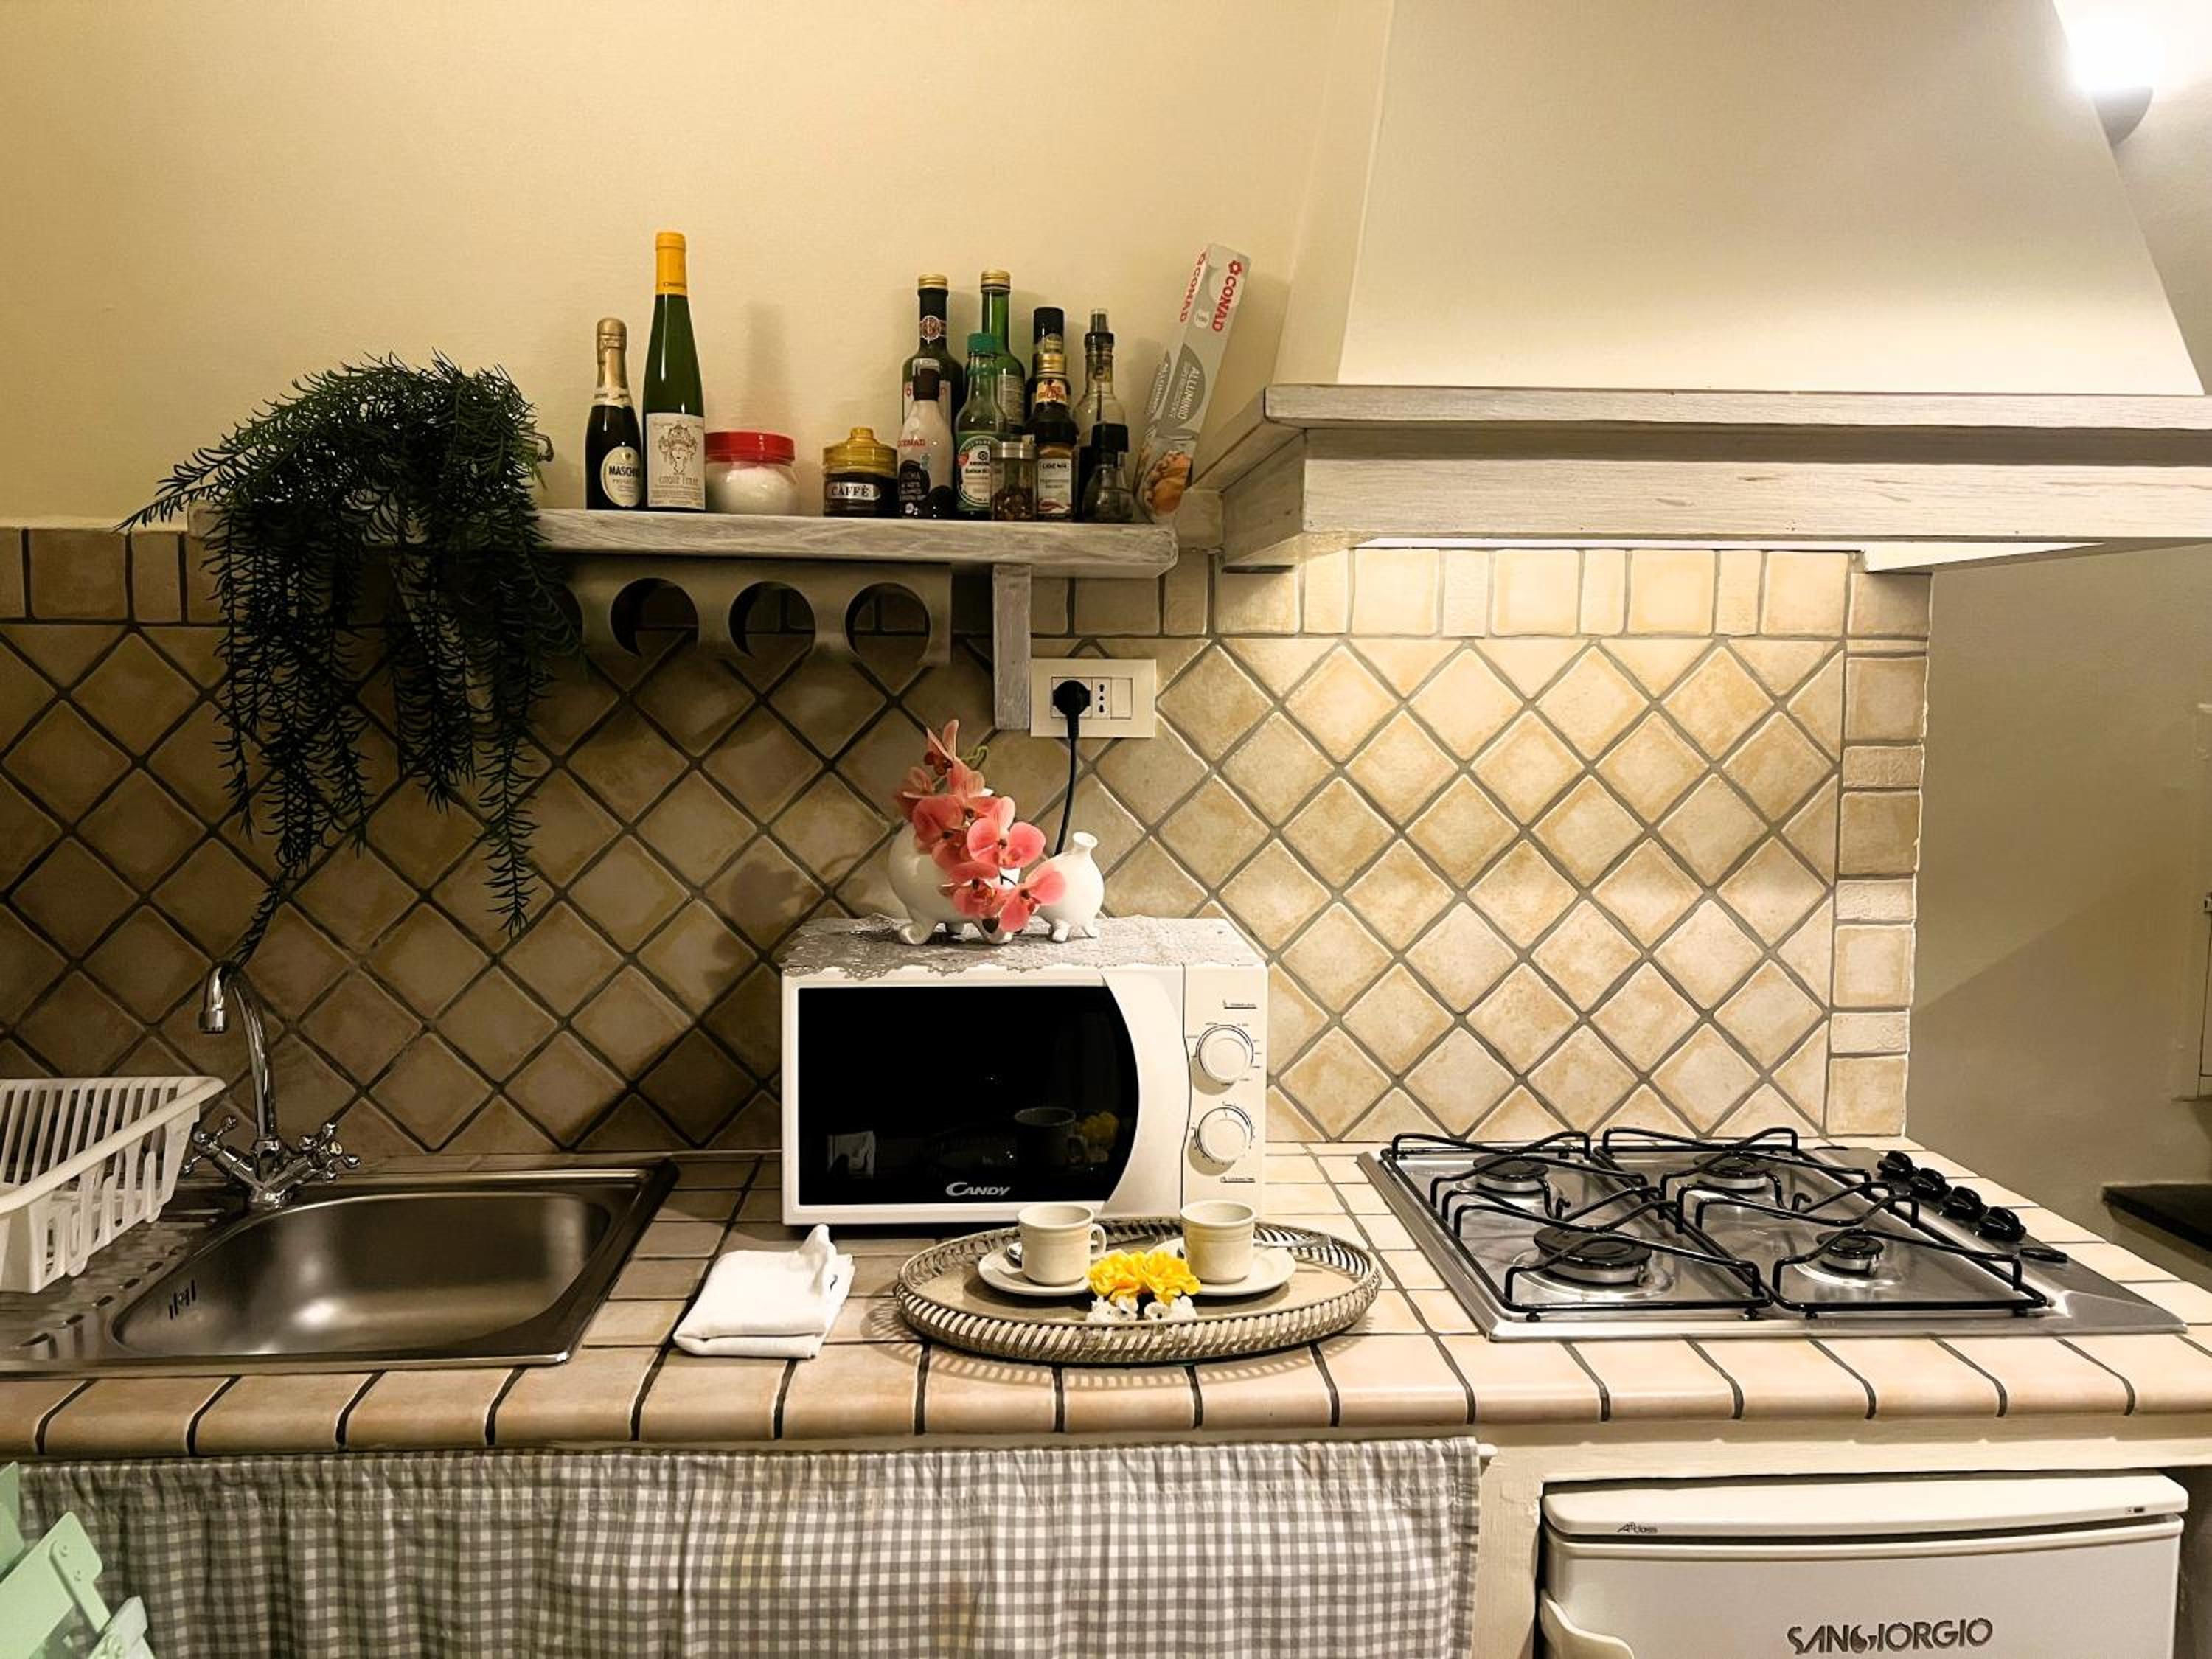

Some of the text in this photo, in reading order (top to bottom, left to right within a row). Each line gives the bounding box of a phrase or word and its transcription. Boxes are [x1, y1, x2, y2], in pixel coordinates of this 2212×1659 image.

[1180, 266, 1200, 323] CONAD
[1212, 276, 1236, 332] CONAD
[831, 485, 869, 497] CAFFÈ
[1787, 1618, 1993, 1655] SANGIORGIO
